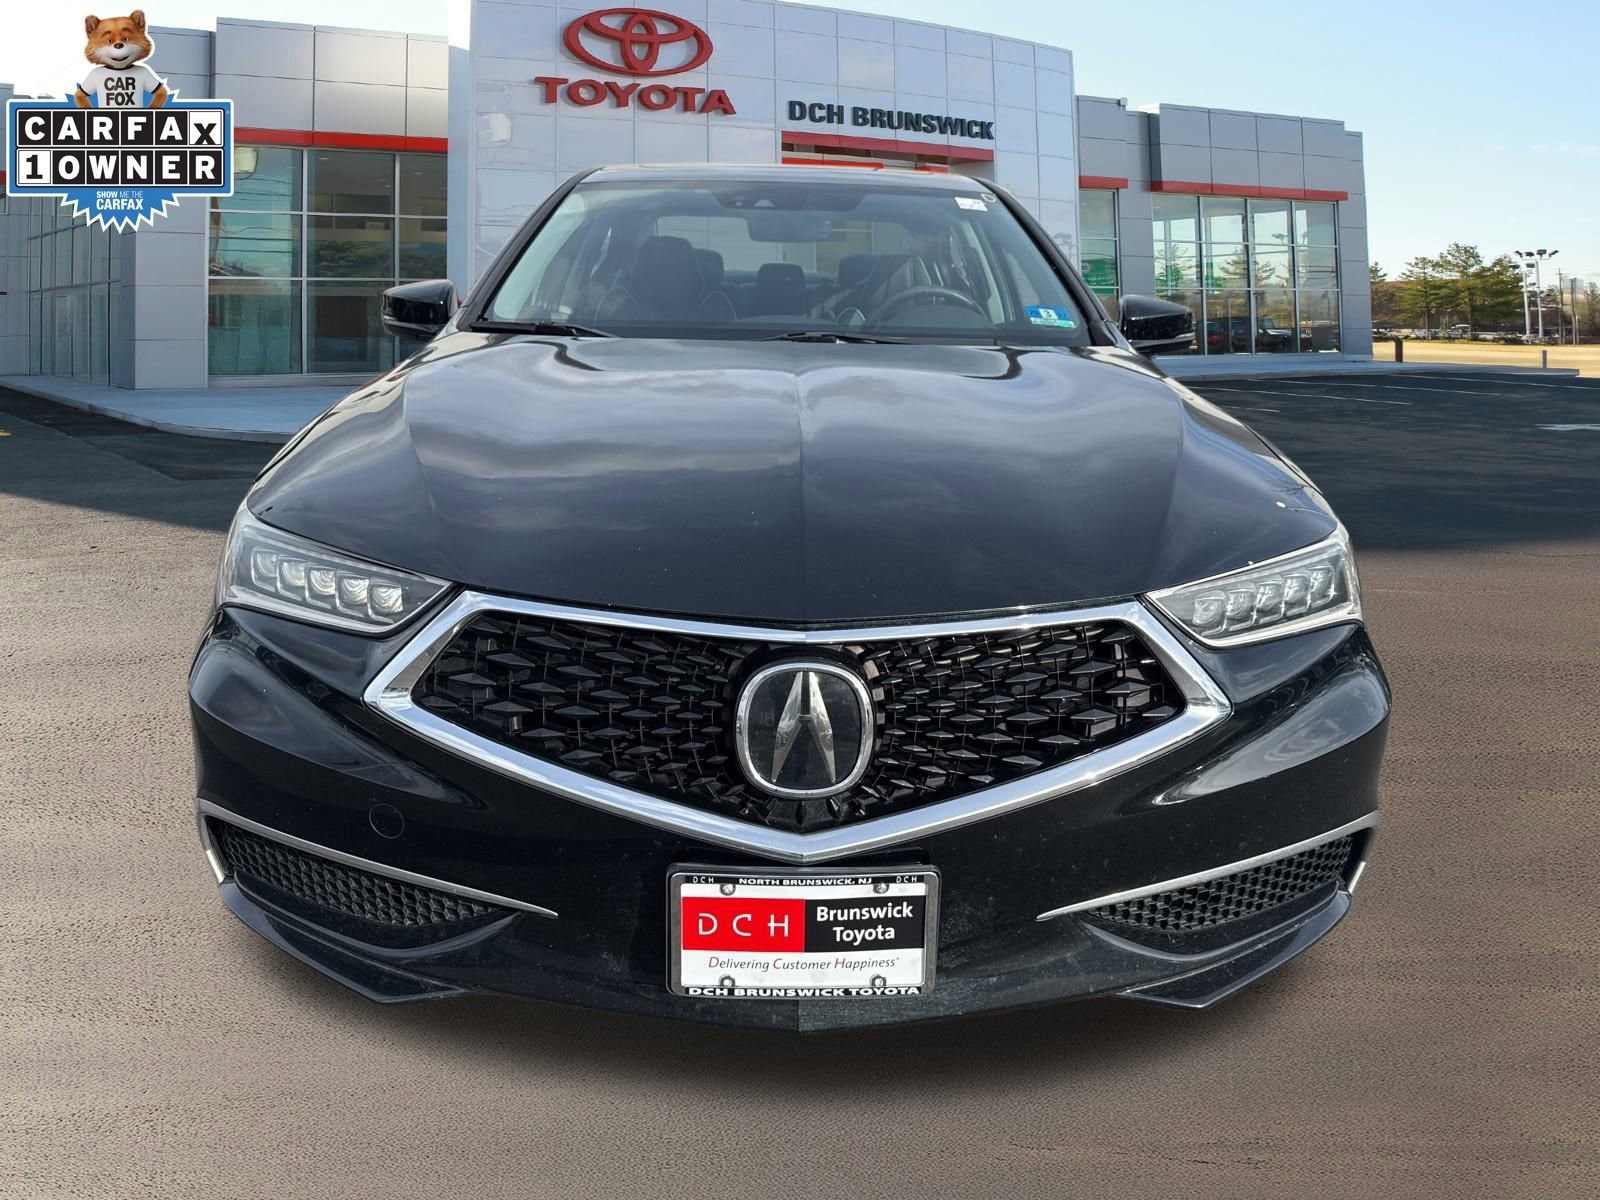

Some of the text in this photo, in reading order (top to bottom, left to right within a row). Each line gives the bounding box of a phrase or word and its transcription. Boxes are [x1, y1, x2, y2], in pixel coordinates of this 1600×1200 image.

[534, 76, 736, 115] TOYOTA
[788, 100, 995, 140] DCH BRUNSWICK
[817, 902, 913, 922] Brunswick
[833, 925, 895, 946] Toyota
[708, 956, 769, 972] Delivering
[773, 958, 831, 970] Customer
[689, 986, 920, 997] DCH BRUNSWICK TOYOTA
